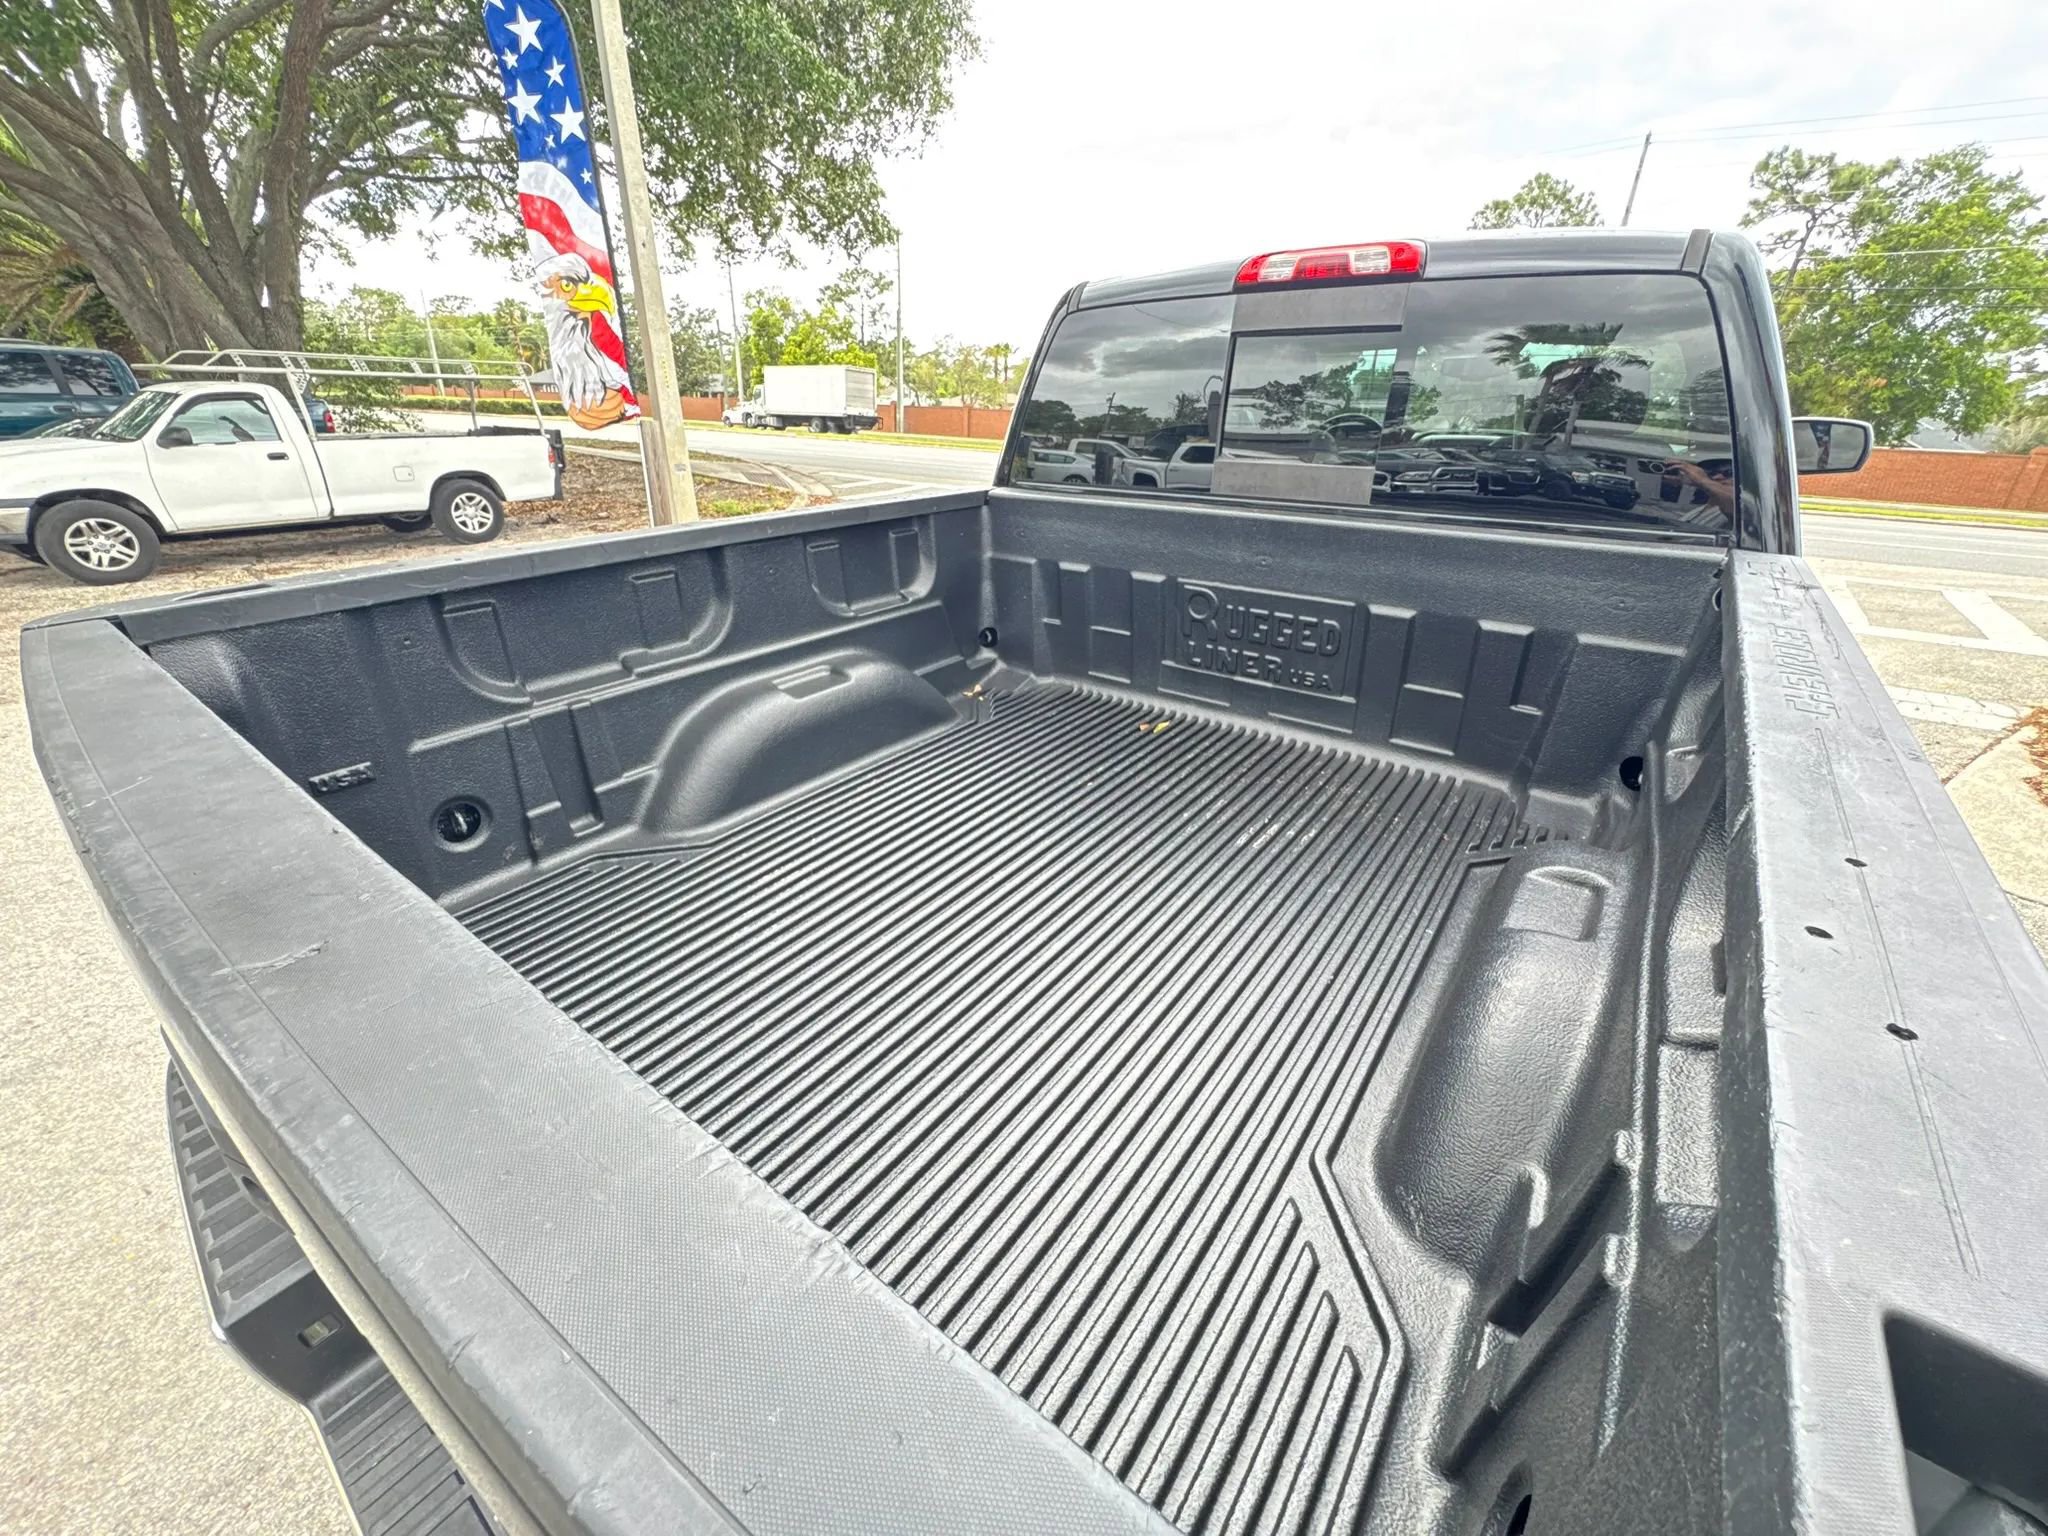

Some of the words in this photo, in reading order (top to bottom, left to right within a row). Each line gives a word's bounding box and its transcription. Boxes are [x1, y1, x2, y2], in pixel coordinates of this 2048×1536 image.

[1183, 584, 1342, 657] RUGGED
[1186, 640, 1283, 684] LINER
[1289, 667, 1333, 691] USA
[1767, 622, 1841, 719] CHEVROLET
